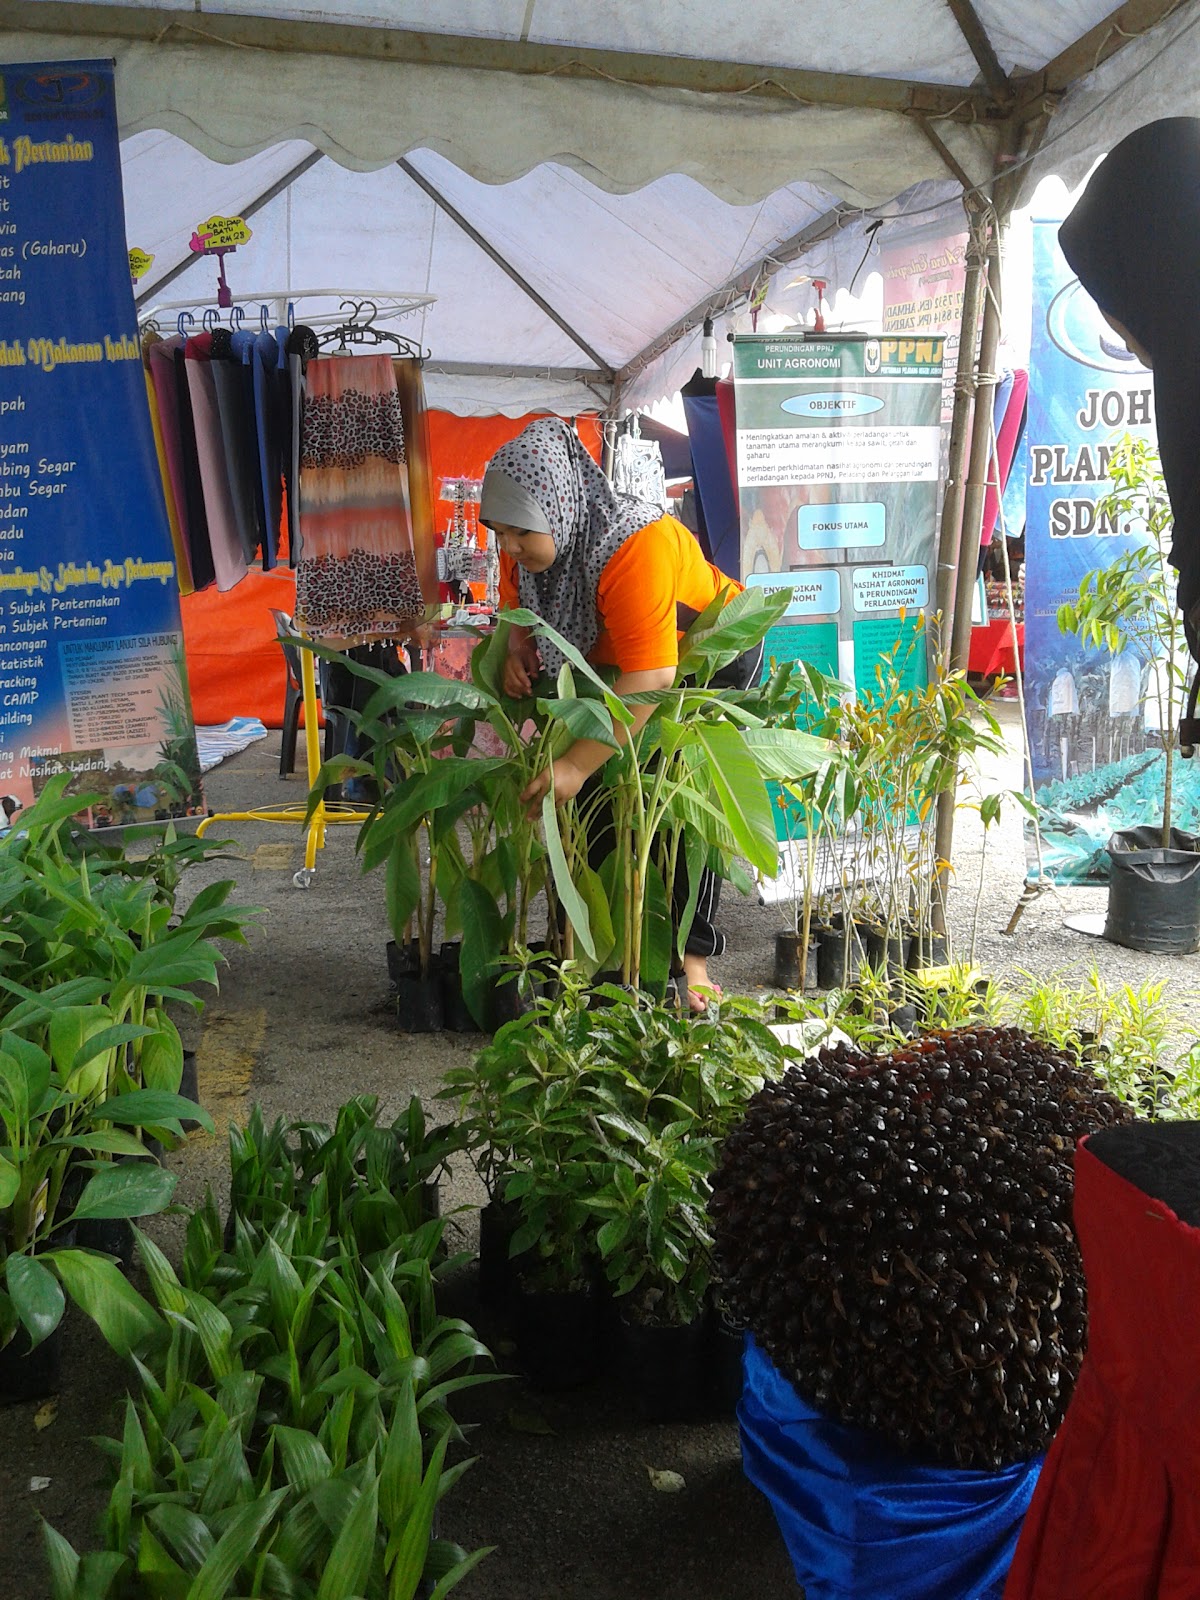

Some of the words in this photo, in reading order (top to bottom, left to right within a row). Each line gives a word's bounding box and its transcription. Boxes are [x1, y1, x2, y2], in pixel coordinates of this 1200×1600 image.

[13, 134, 93, 173] Pertanian
[213, 227, 233, 236] BATU
[220, 235, 232, 243] RM
[22, 238, 87, 260] (Gaharu)
[28, 336, 103, 372] Makanan
[104, 333, 140, 362] halal
[765, 345, 815, 353] PERUNDINGAN
[881, 337, 943, 363] PPNJ
[757, 358, 782, 369] UNIT
[784, 358, 841, 369] AGRONOMI
[809, 400, 857, 410] OBJEKTIF
[1080, 389, 1152, 428] JOH
[746, 434, 793, 442] Meningkatkan
[746, 452, 770, 460] gaharu
[38, 458, 76, 476] Segar
[777, 463, 824, 472] perkhidmatan
[1032, 445, 1140, 484] PLAN
[747, 474, 788, 482] perladangan
[790, 473, 815, 481] kepada
[28, 480, 67, 498] Segar
[1052, 499, 1131, 536] SDN.
[812, 523, 842, 531] FOKUS
[844, 522, 869, 530] UTAMA
[872, 569, 906, 579] KHIDMAT
[854, 580, 885, 589] NASIHAT
[887, 578, 925, 587] AGRONOMI
[866, 588, 918, 598] PERUNDINGAN
[9, 601, 46, 616] Subjek
[51, 595, 120, 611] Penternakan
[864, 598, 915, 608] PERLADANGAN
[12, 619, 48, 634] Subjek
[54, 615, 107, 630] Pertanian
[4, 691, 39, 706] CAMP
[20, 744, 62, 758] Makmal
[19, 762, 63, 777] Nasihat
[70, 757, 111, 772] Ladang
